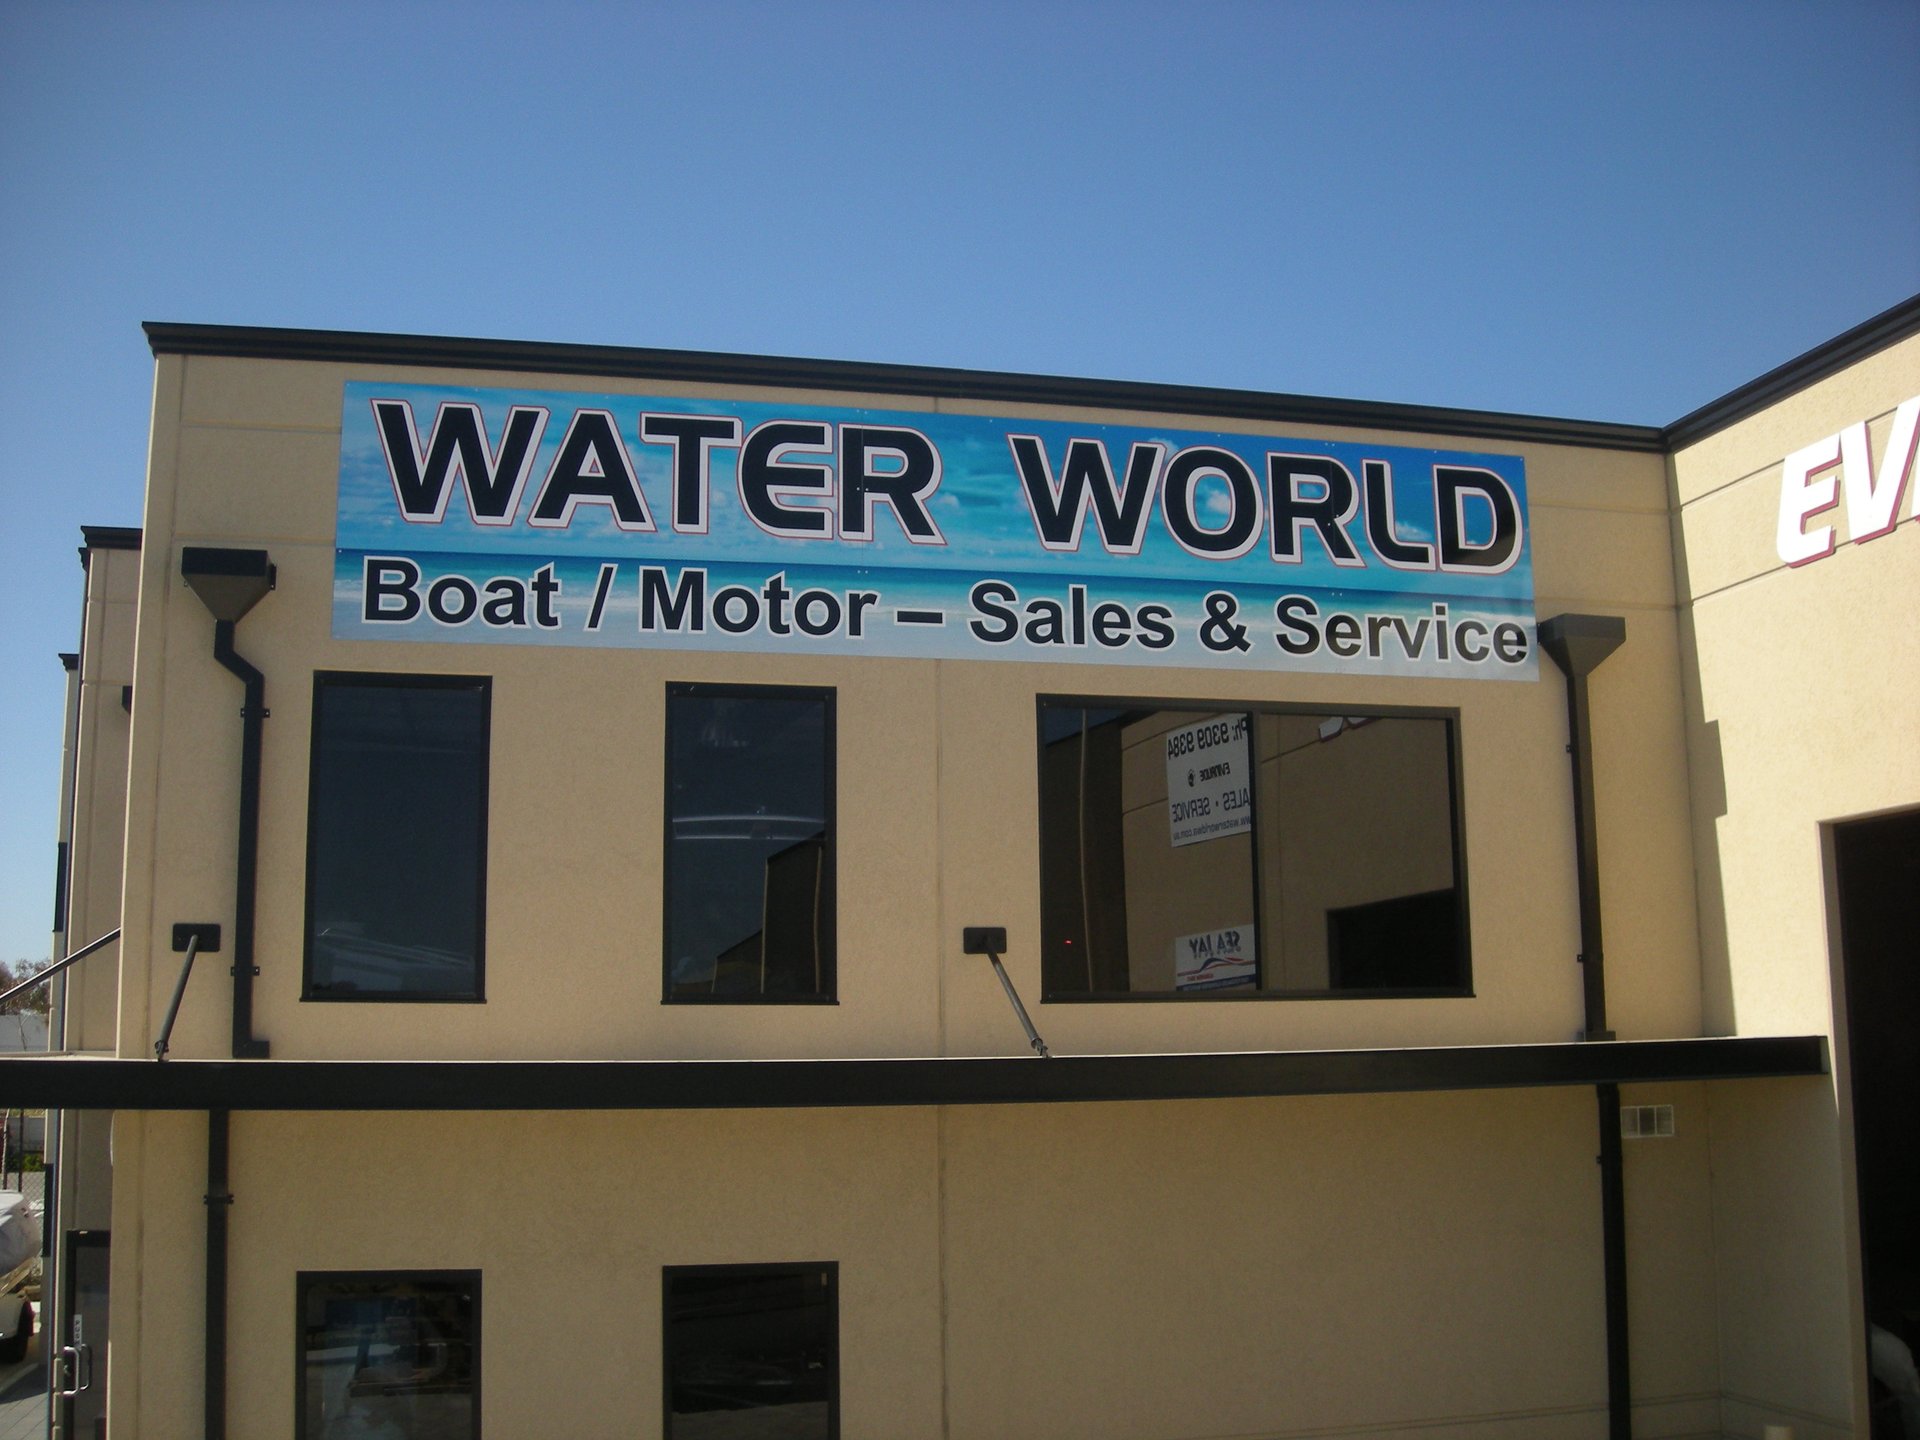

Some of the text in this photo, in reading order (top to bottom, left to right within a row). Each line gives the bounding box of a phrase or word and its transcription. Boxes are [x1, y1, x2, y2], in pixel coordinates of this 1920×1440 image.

[370, 399, 1524, 575] WATER WORLD
[1776, 394, 1920, 569] EV
[362, 555, 560, 629] Boat
[583, 563, 618, 632] /
[639, 567, 880, 639] Motor
[968, 578, 1175, 649] Sales
[1200, 590, 1253, 655] &
[1275, 594, 1529, 664] Service
